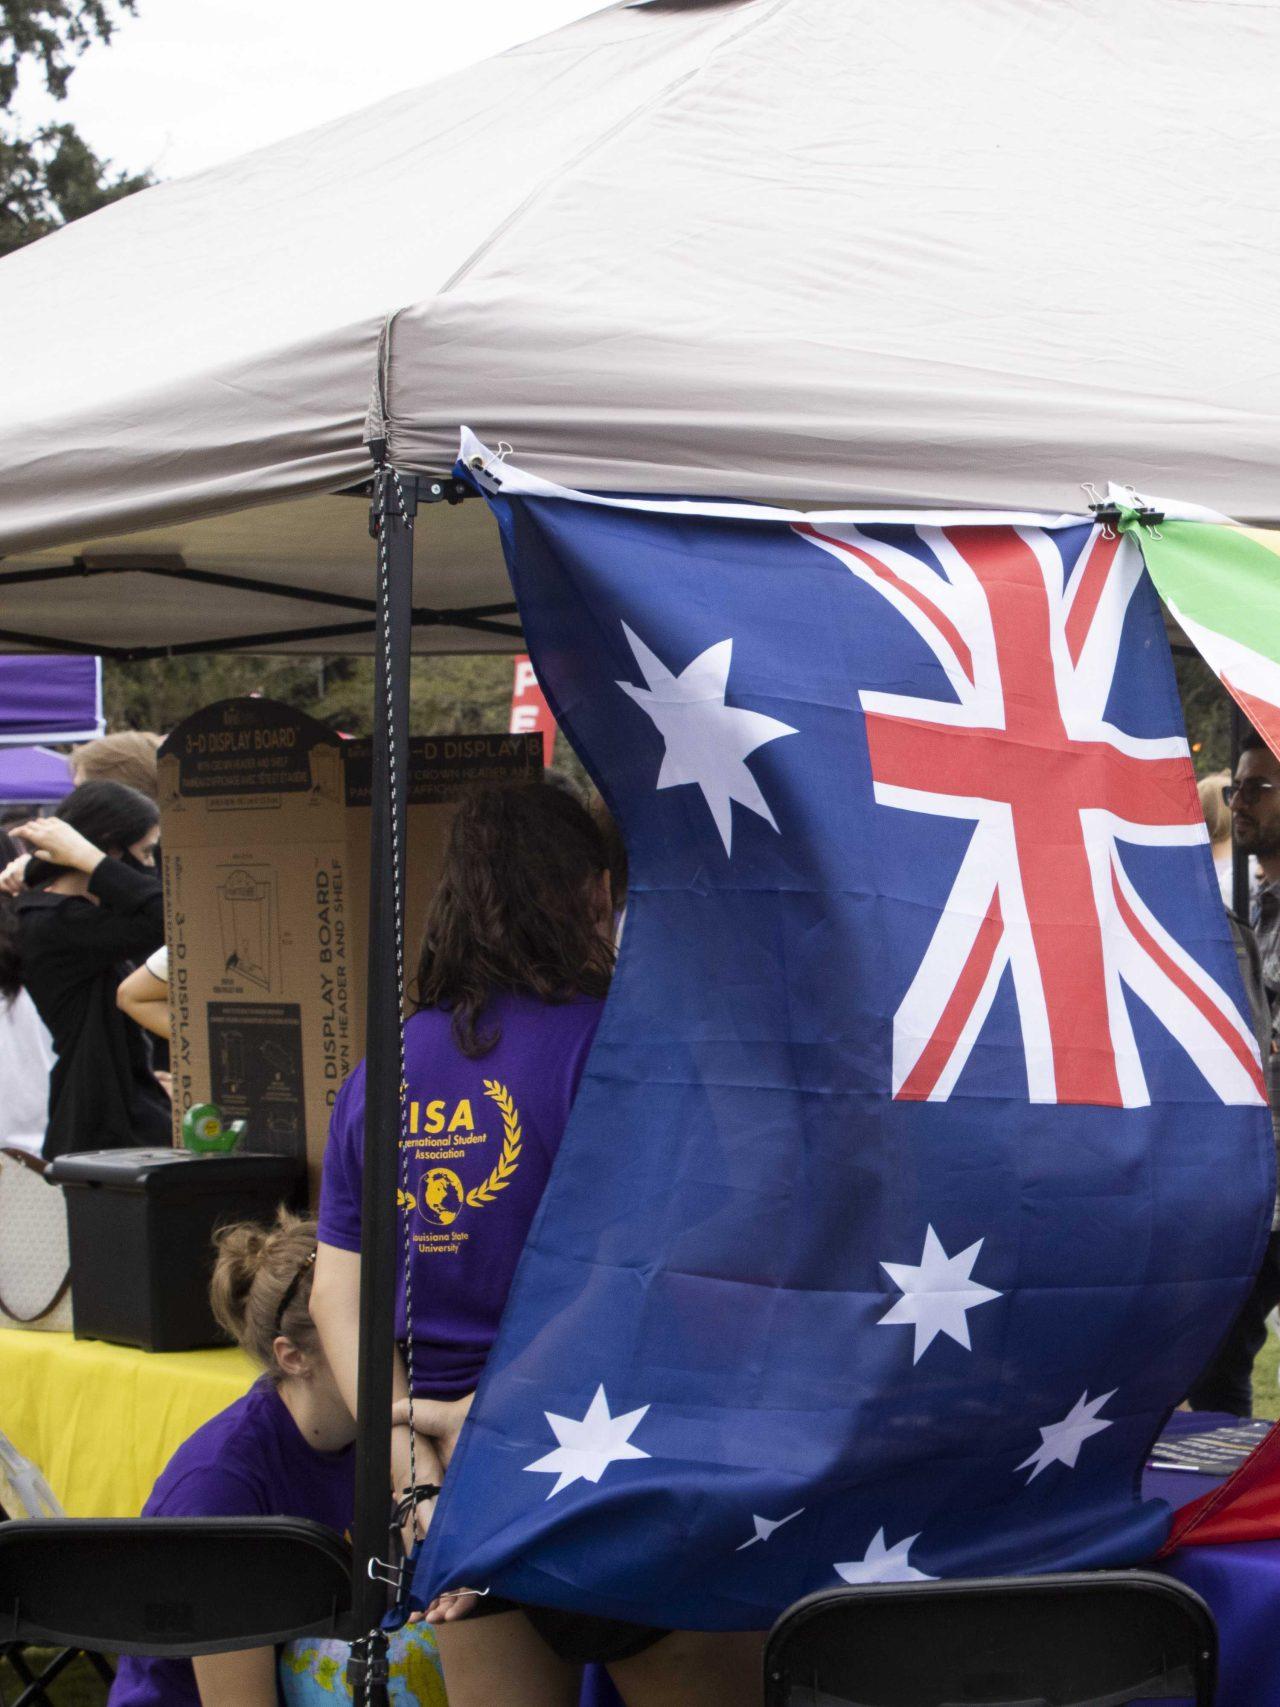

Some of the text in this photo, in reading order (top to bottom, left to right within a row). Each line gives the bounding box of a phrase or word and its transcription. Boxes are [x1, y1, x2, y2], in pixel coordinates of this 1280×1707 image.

[186, 727, 296, 754] 3-D DISPLAY BOARD
[411, 741, 437, 760] -D
[444, 738, 522, 760] DISPLAY
[331, 858, 344, 913] SHELF
[316, 871, 332, 963] BOARD
[334, 920, 345, 959] AND
[177, 969, 192, 1066] DISPLAY
[336, 966, 348, 1039] HEADER
[320, 973, 337, 1079] DISPLAY
[409, 1099, 475, 1134] ISA
[415, 1148, 465, 1160] Association
[453, 1132, 487, 1146] Student
[418, 1243, 459, 1254] University
[451, 1231, 469, 1241] State
